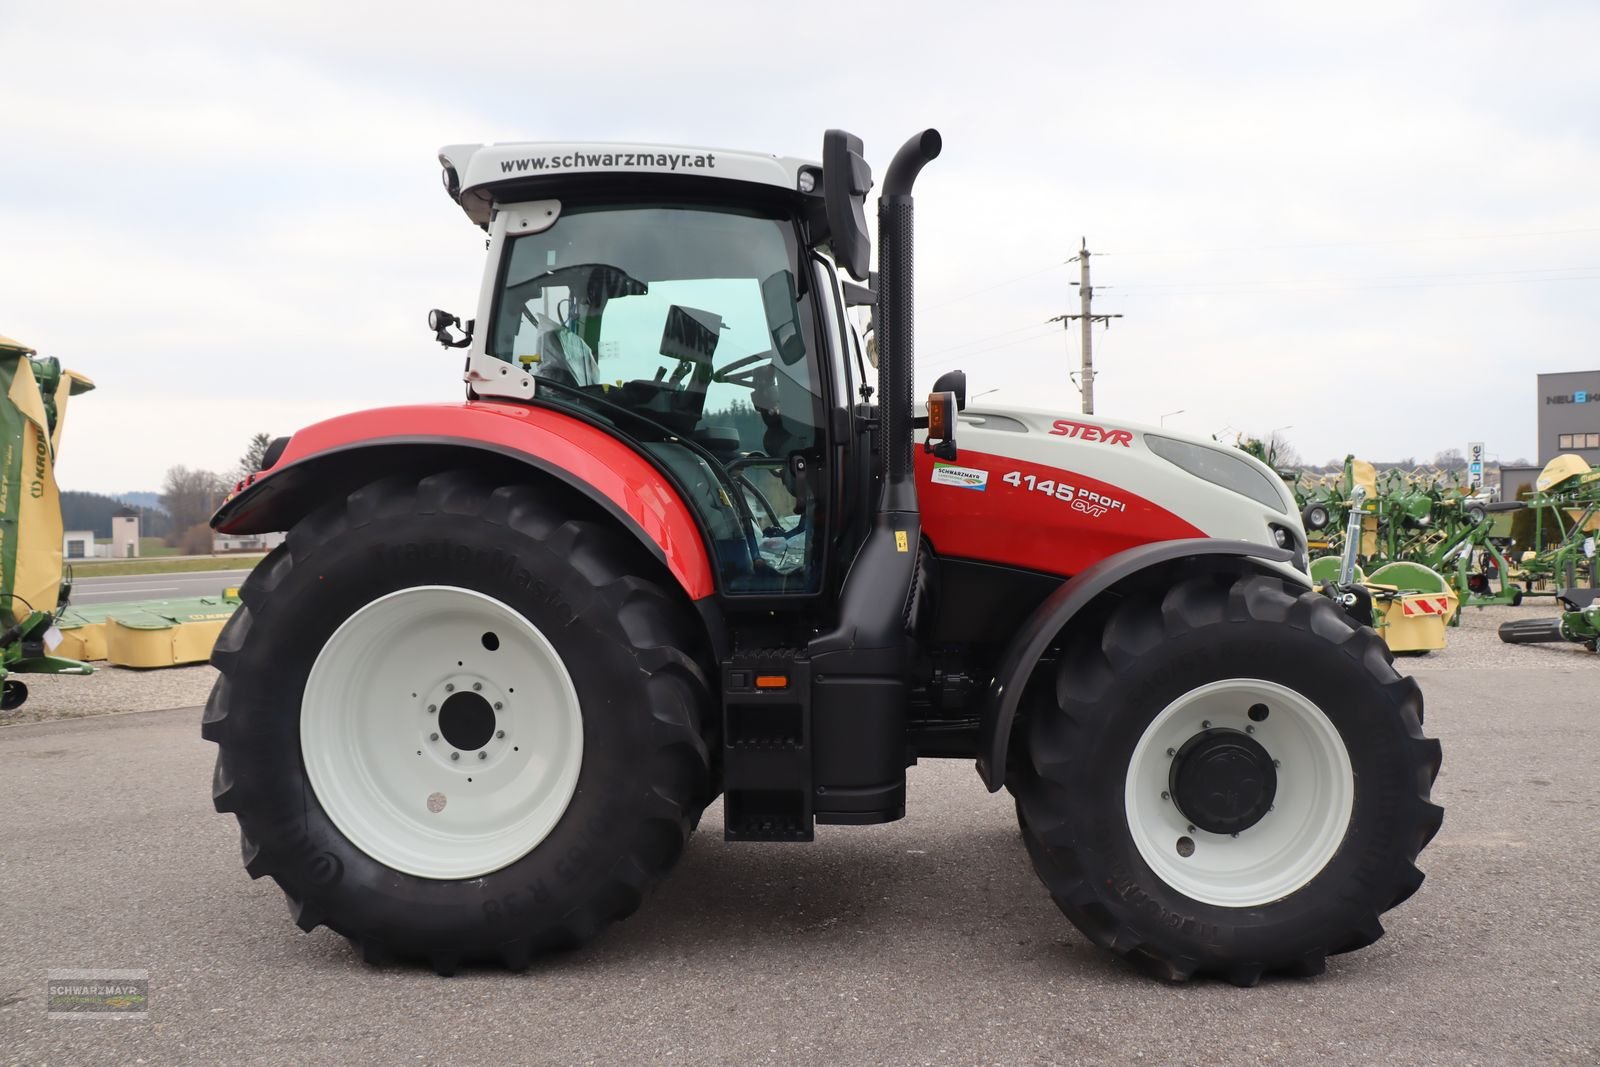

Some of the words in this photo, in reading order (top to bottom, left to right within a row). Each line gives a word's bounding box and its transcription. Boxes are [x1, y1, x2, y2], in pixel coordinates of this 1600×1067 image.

[501, 152, 715, 173] www.schwarzmayr.at
[1546, 391, 1600, 405] NEUBIK
[1048, 419, 1133, 448] STEYR
[35, 427, 46, 480] KRON
[938, 468, 980, 479] SCHWARZMAYR
[1002, 471, 1074, 502] 4145
[1077, 488, 1126, 513] PROFI
[1071, 499, 1107, 517] CVT
